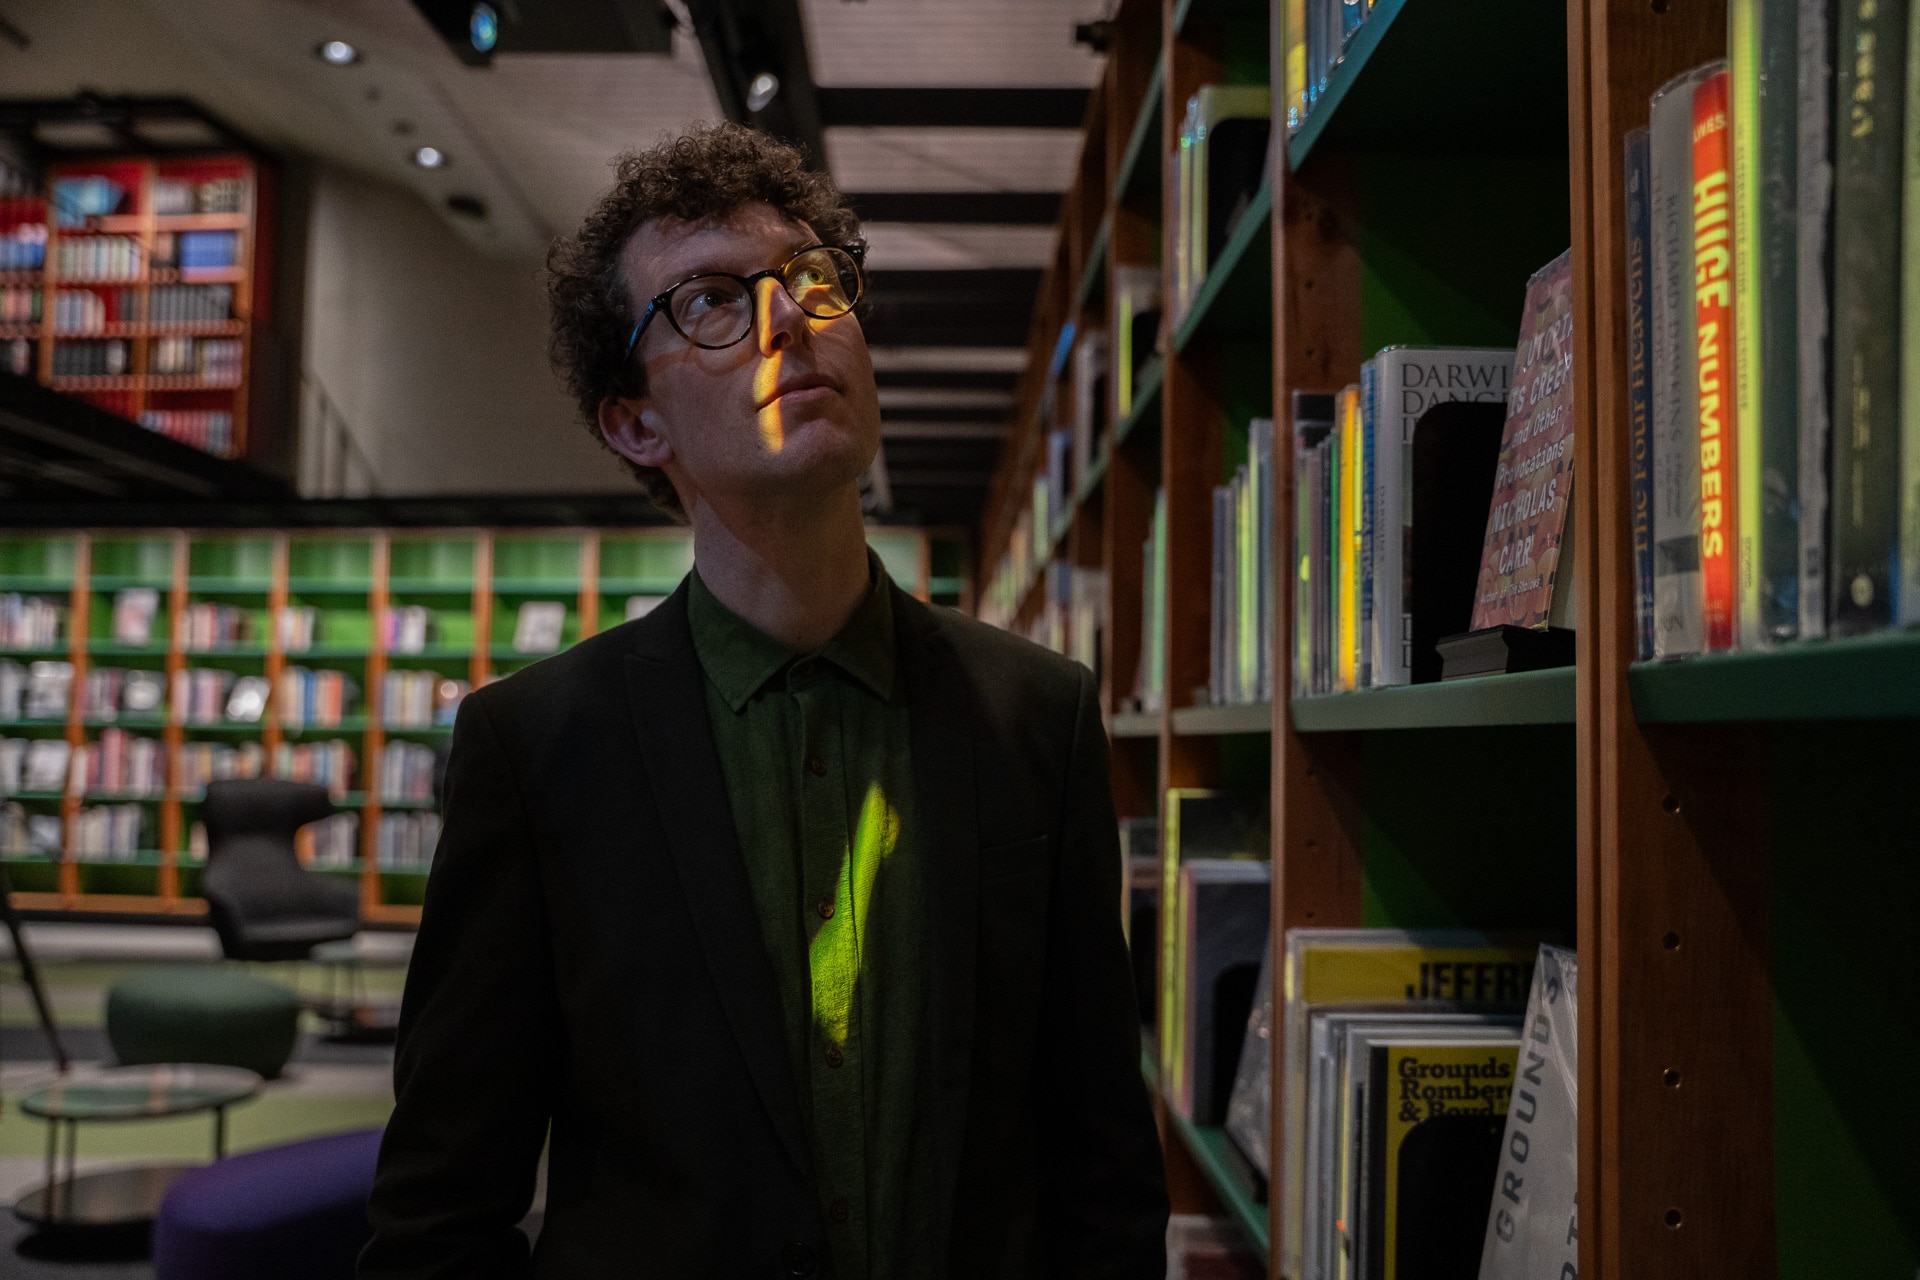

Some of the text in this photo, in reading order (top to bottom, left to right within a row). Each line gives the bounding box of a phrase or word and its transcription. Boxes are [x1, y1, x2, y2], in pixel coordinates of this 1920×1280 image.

[1666, 194, 1681, 311] RICHARD
[1668, 318, 1681, 442] DAWKINS
[1693, 170, 1731, 559] HUGE NUMBERS
[1533, 405, 1563, 437] Other
[1498, 439, 1565, 489] Provocations
[1492, 478, 1557, 534] NICHOLAS
[1498, 535, 1532, 575] CARR
[1398, 1056, 1511, 1079] Grounds
[1398, 1100, 1421, 1122] &
